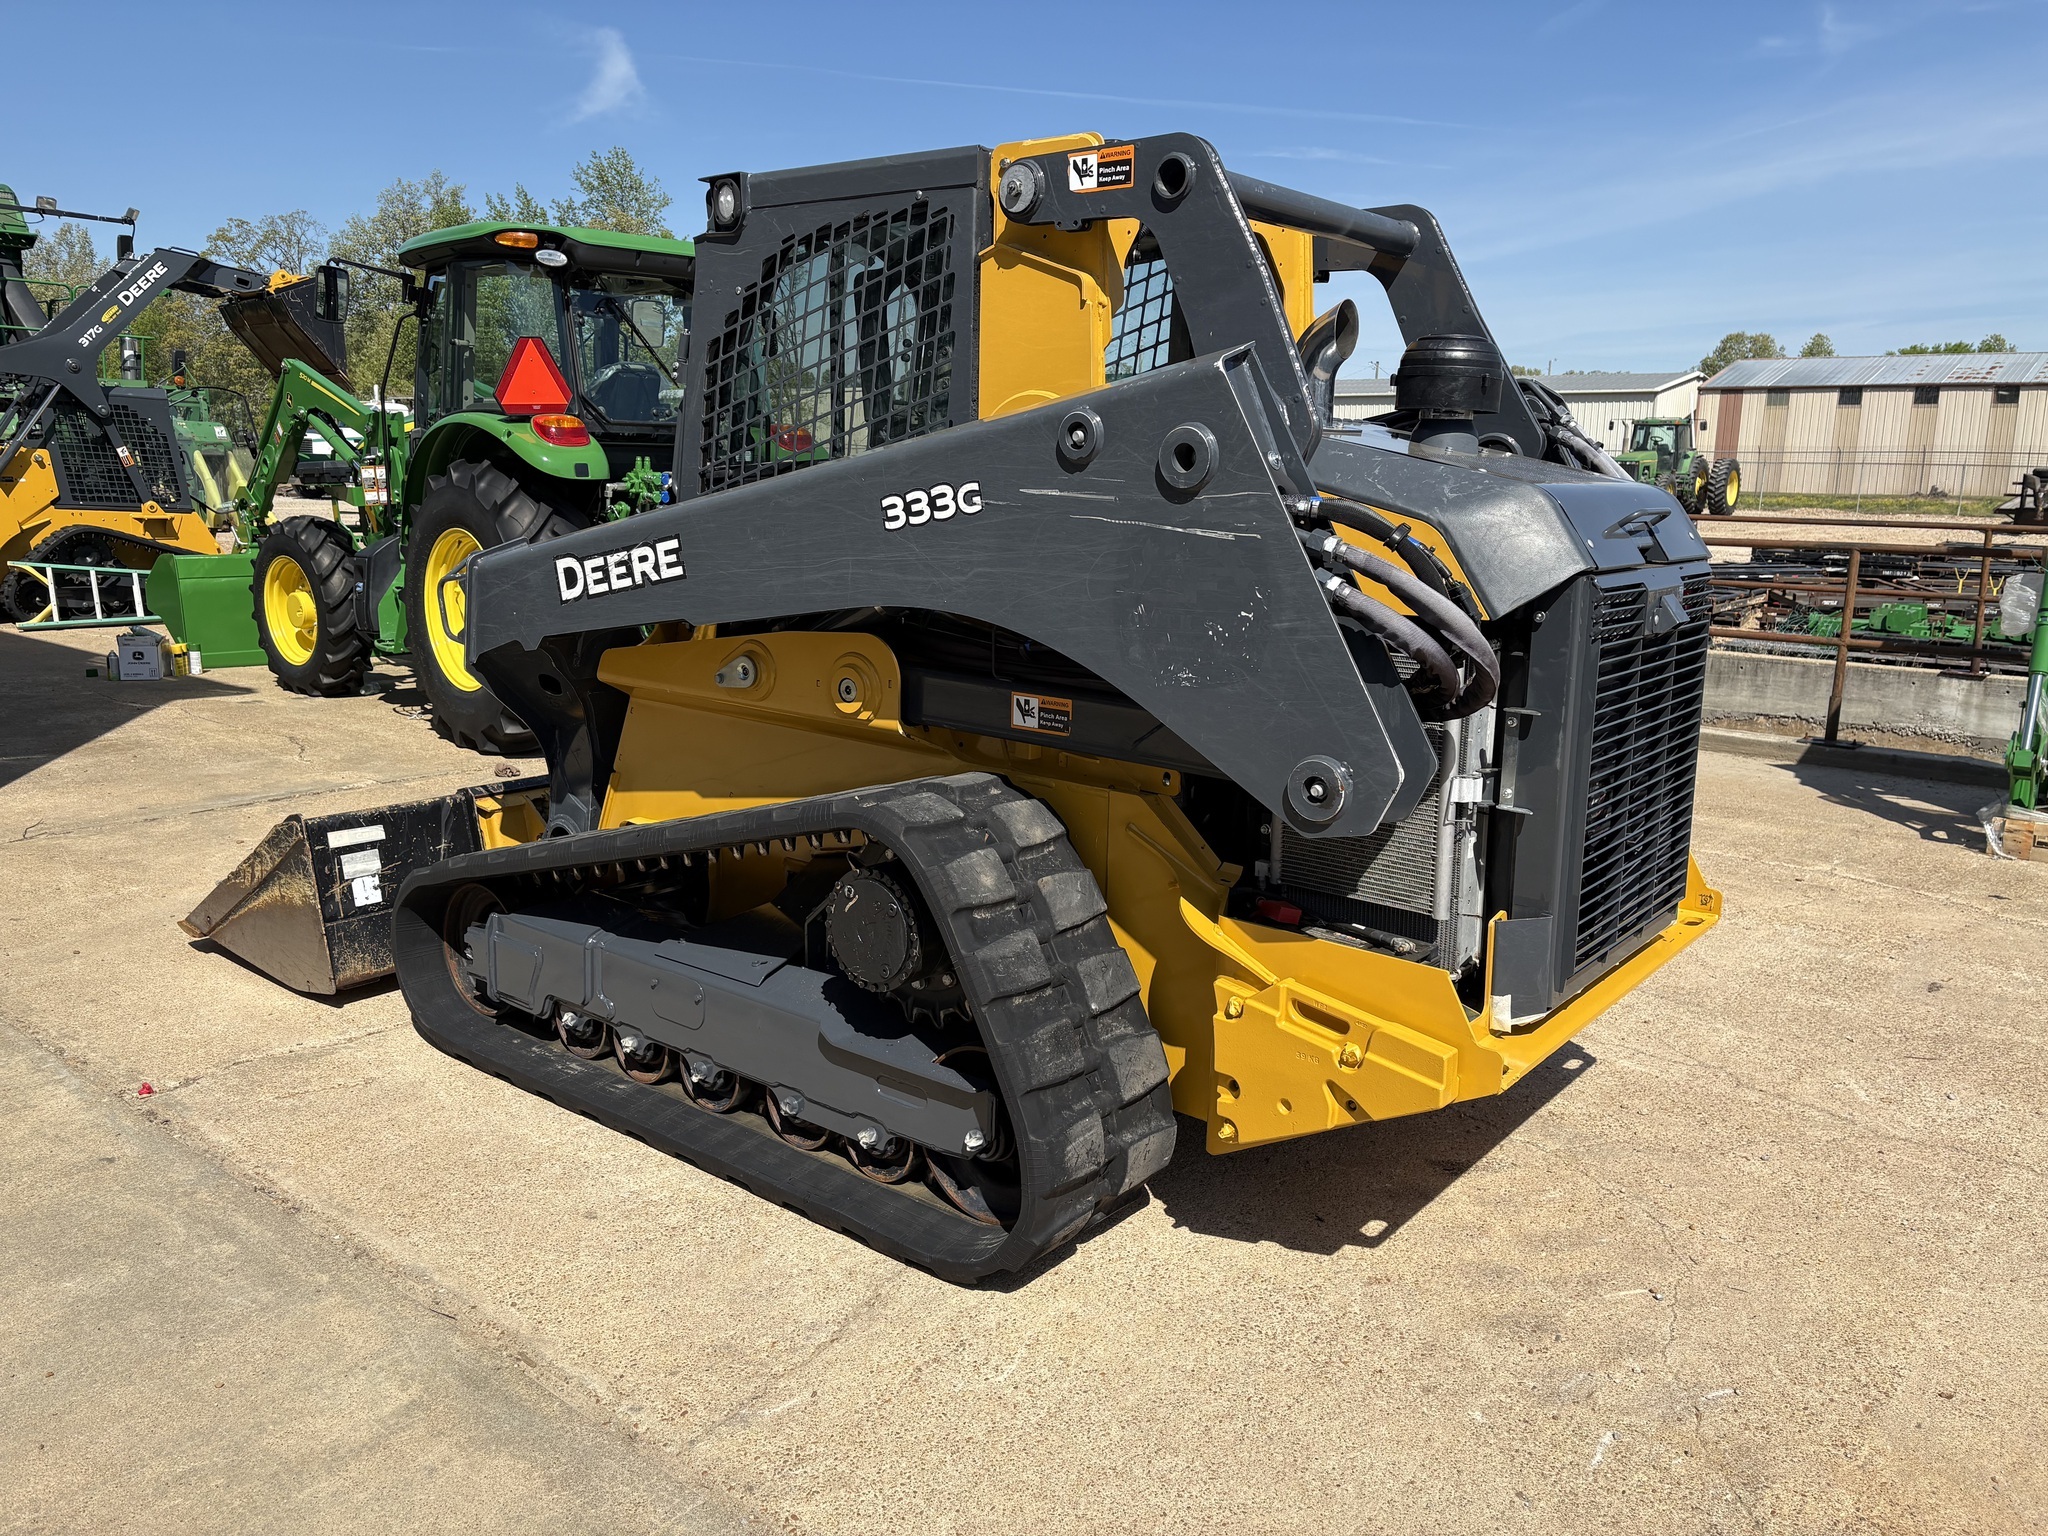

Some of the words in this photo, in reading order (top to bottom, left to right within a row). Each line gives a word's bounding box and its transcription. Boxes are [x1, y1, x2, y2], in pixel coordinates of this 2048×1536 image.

[1105, 149, 1131, 158] WARNING
[1099, 166, 1115, 174] Pinch
[117, 261, 169, 307] DEERE
[78, 324, 103, 348] 317G
[881, 482, 983, 530] 333G
[555, 538, 684, 601] DEERE
[1046, 700, 1069, 708] WARNING
[1040, 711, 1054, 719] Pinch
[1052, 721, 1064, 729] Away
